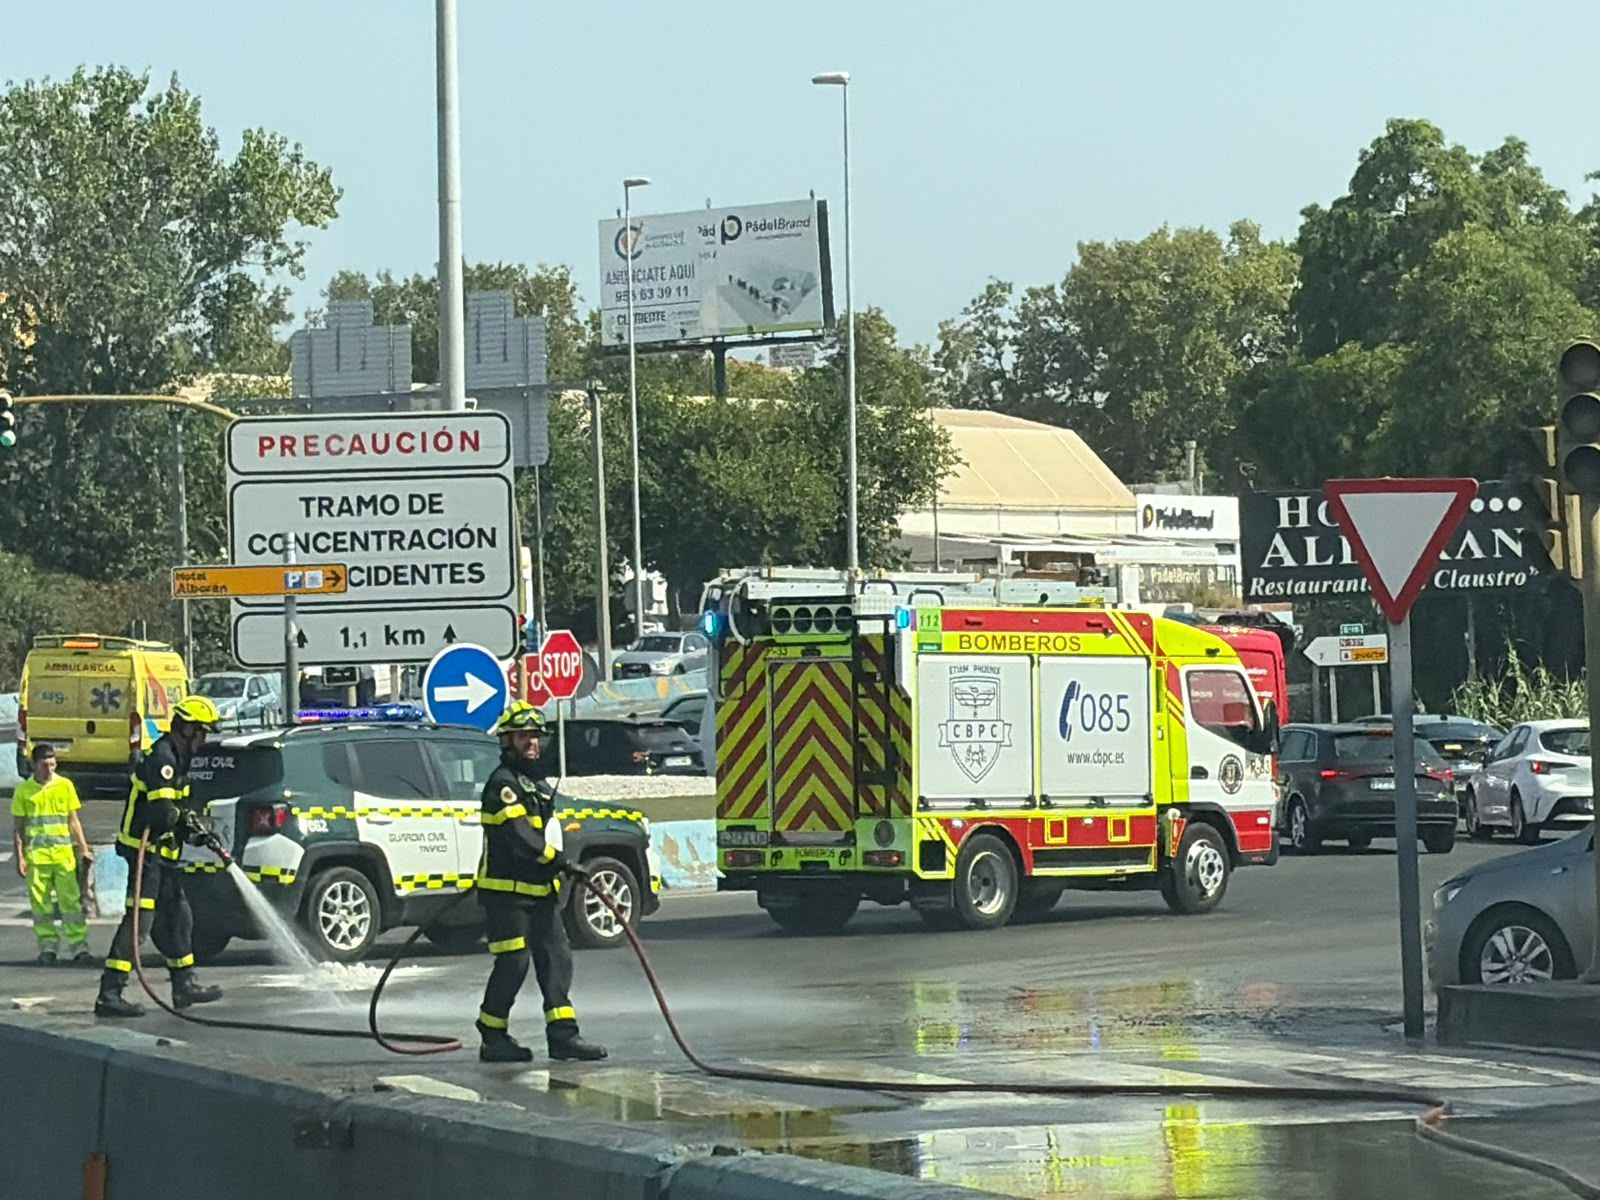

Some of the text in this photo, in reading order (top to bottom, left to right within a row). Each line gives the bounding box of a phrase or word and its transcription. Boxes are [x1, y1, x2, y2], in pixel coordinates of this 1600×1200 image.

[258, 426, 480, 458] PRECAUCIÓN
[299, 493, 444, 519] TRAMO DE
[247, 523, 497, 556] CONCENTRACIÓN
[348, 562, 486, 588] CIDENTES
[1250, 576, 1372, 597] Restaurant
[920, 614, 939, 627] 112
[384, 625, 425, 646] km
[959, 634, 1082, 651] BOMBEROS
[543, 652, 580, 679] STOP
[1080, 693, 1131, 732] 085
[1067, 747, 1125, 768] www.cbpc.es
